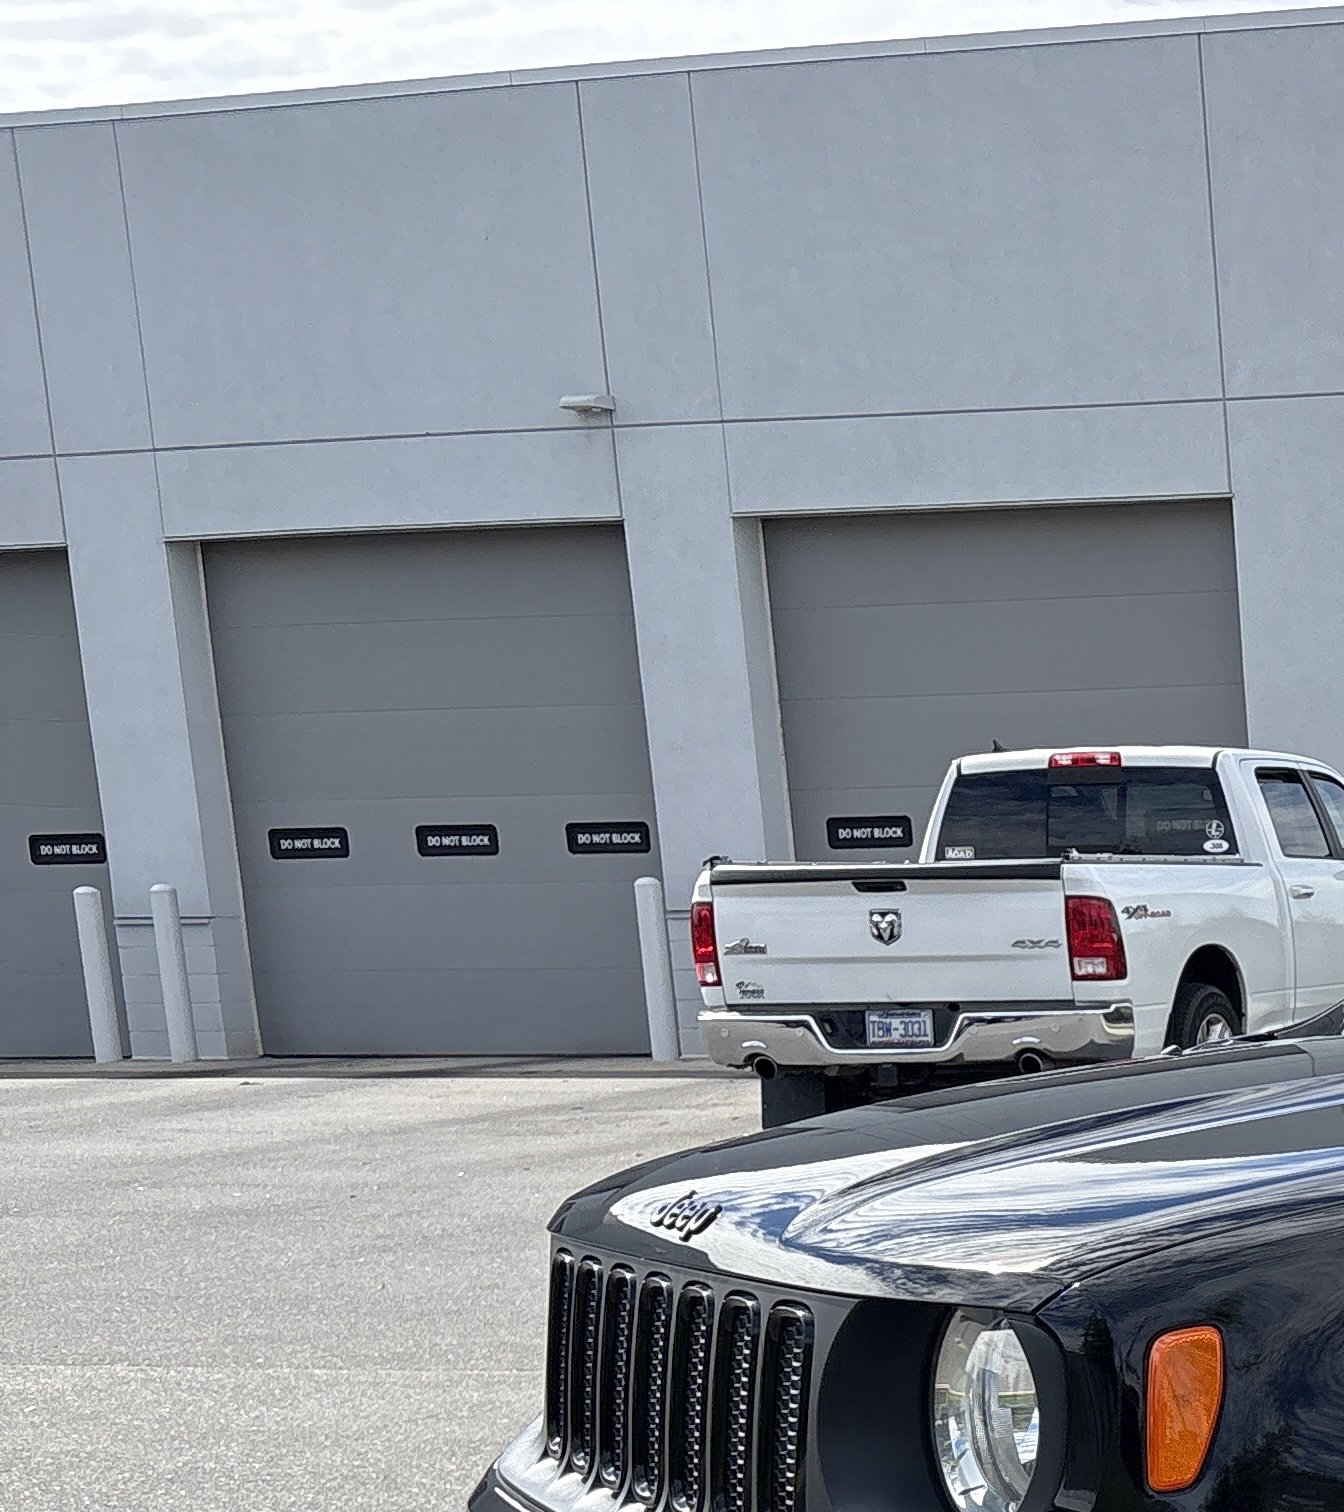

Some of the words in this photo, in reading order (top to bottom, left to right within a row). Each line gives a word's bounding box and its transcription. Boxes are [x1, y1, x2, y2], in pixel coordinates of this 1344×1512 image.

[577, 833, 590, 844] DO
[592, 833, 610, 844] NOT
[612, 832, 641, 843] BLOCK
[837, 828, 851, 839] DO
[853, 828, 872, 839] NOT
[873, 827, 903, 838] BLOCK
[280, 839, 292, 849] DO
[294, 839, 311, 849] NOT
[313, 838, 341, 848] BLOCK
[427, 835, 440, 846] DO
[442, 835, 460, 846] NOT
[461, 835, 490, 845] BLOCK
[40, 844, 52, 855] DO
[54, 844, 70, 854] NOT
[72, 844, 98, 854] BLOCK
[649, 1190, 723, 1242] Jeep
